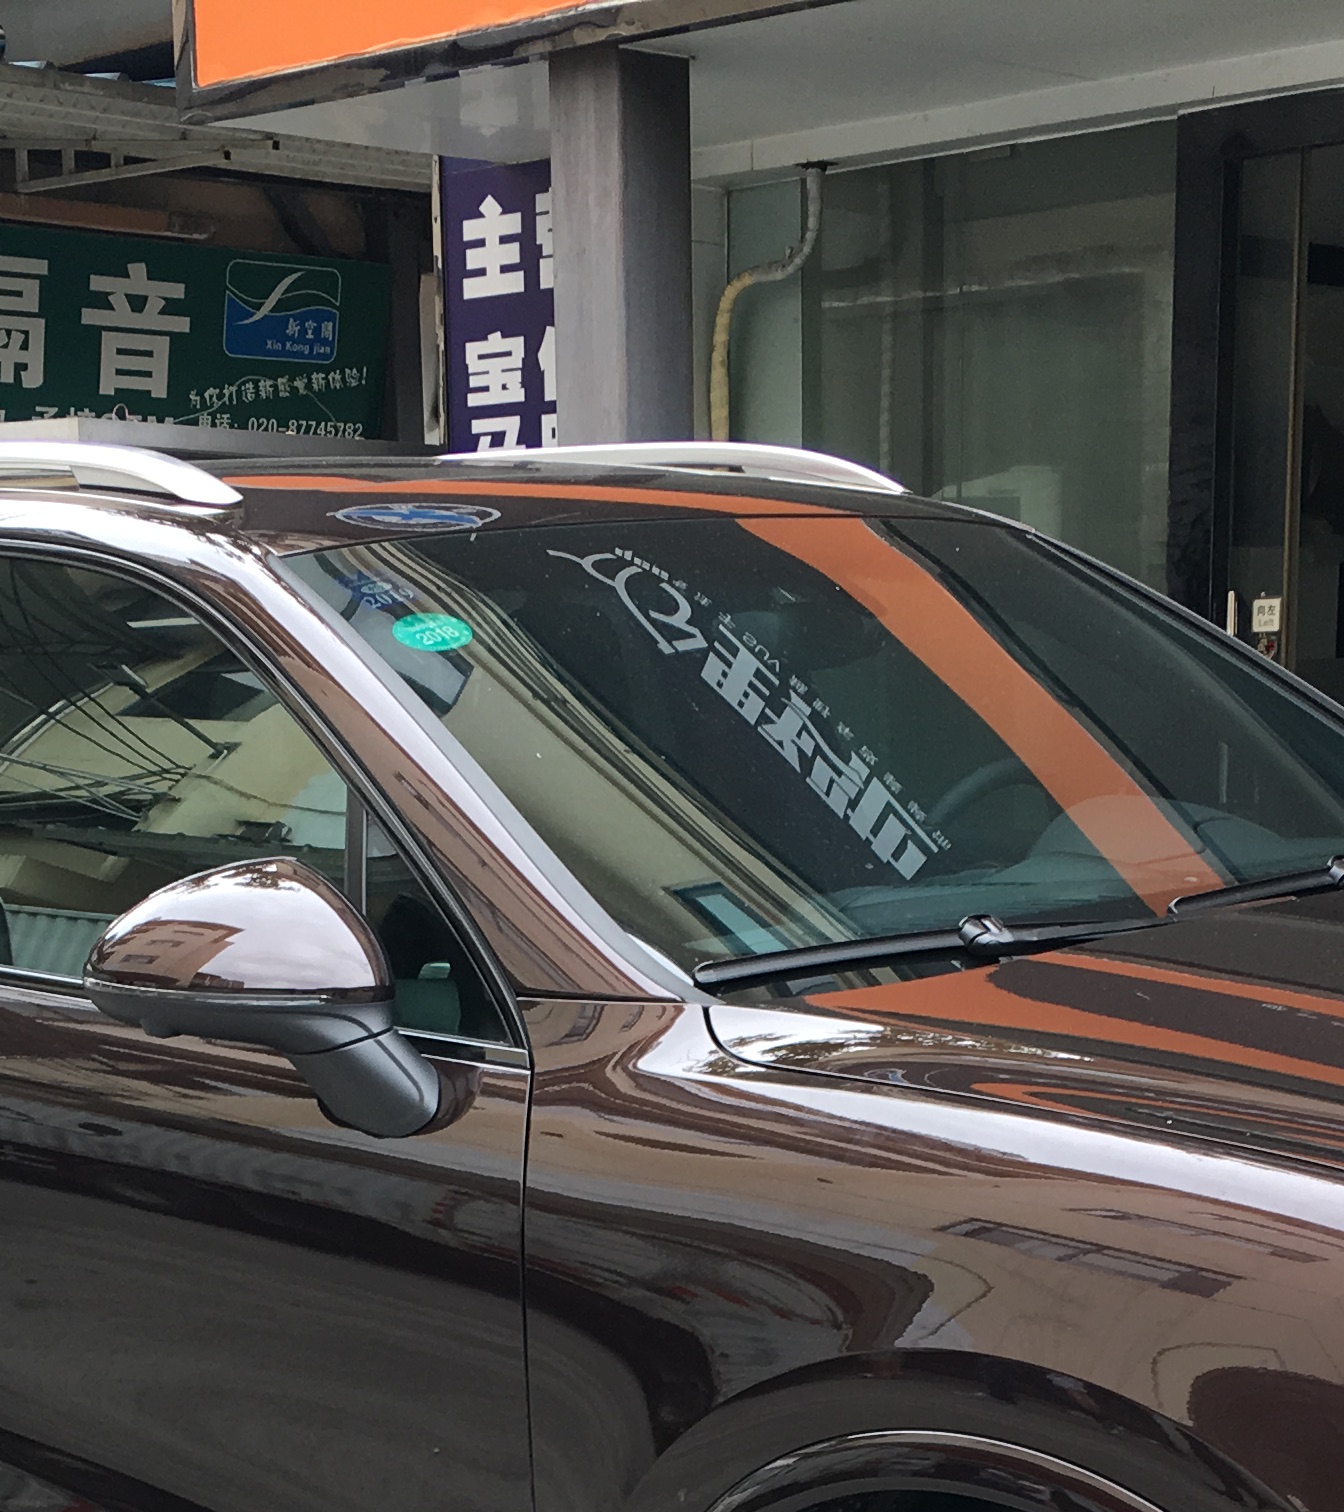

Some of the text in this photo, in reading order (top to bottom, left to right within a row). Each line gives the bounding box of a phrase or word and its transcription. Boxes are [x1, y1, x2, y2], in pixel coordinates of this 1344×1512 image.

[265, 339, 331, 355] Xin Kong jian
[415, 624, 460, 646] 2018
